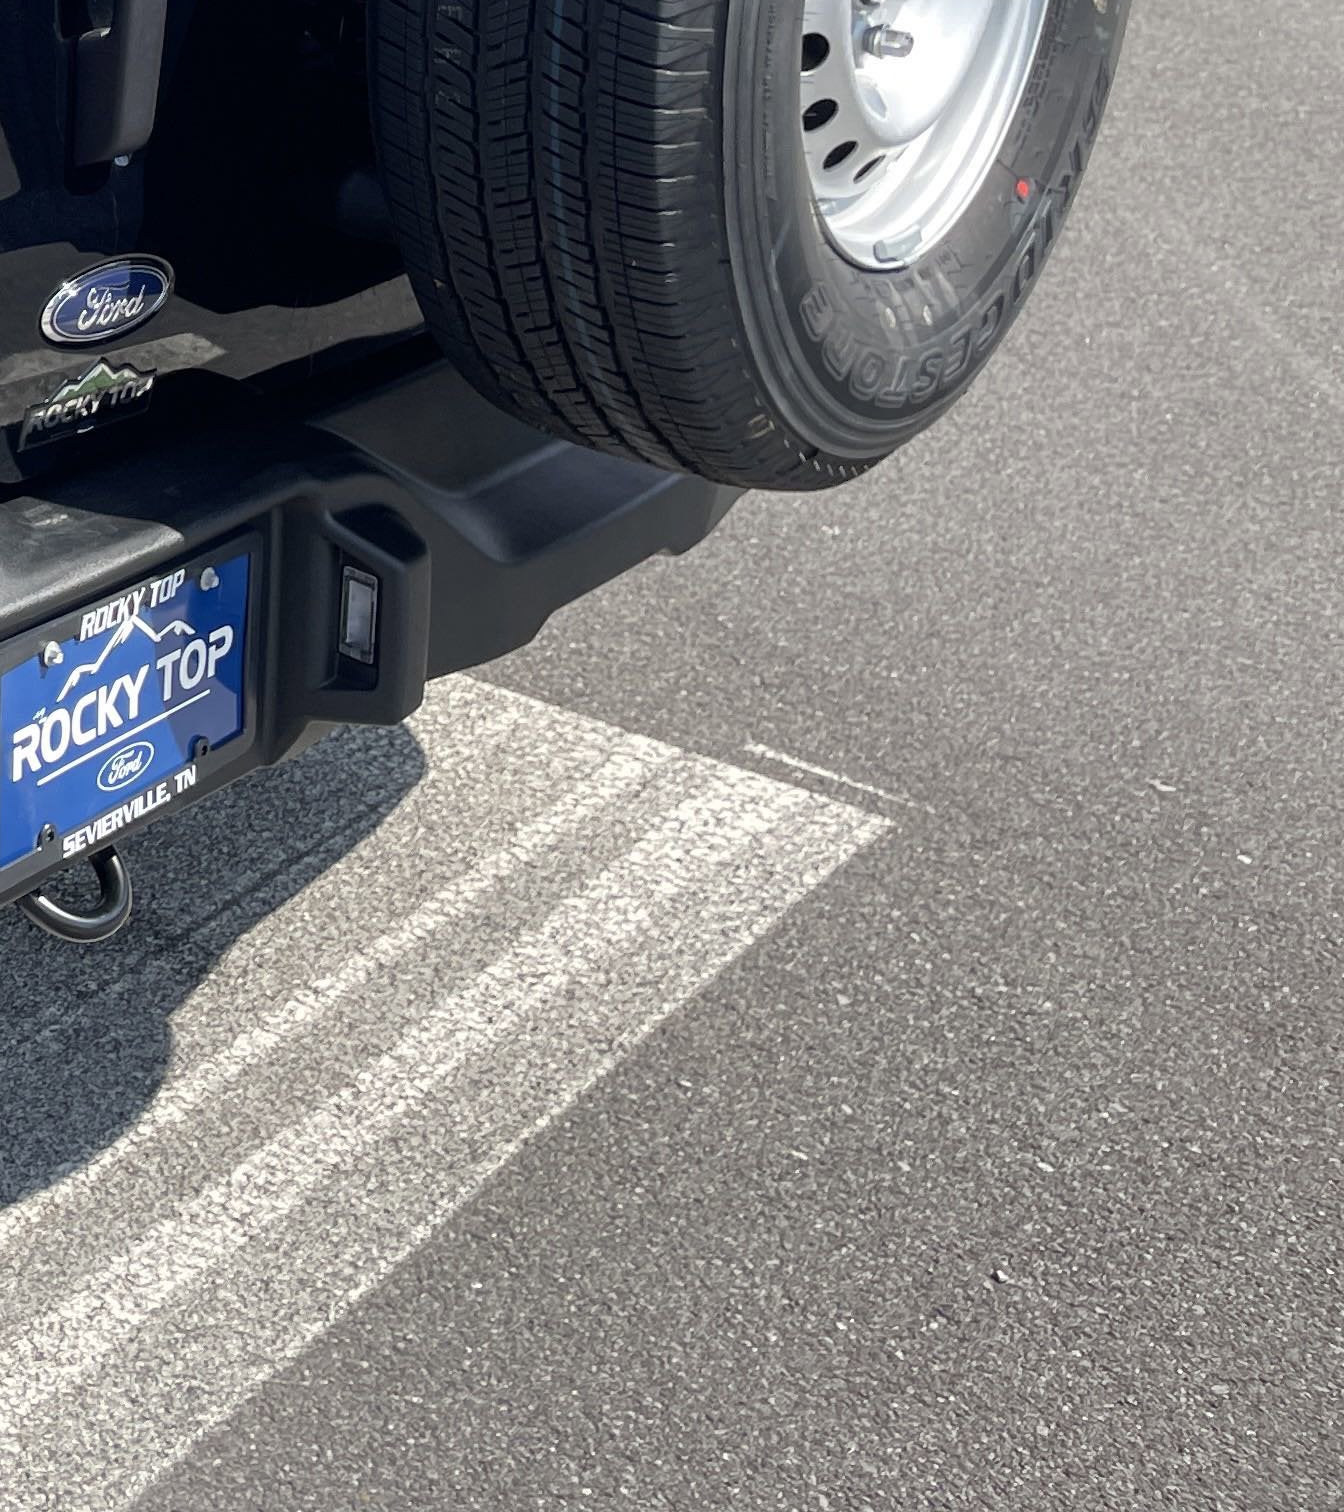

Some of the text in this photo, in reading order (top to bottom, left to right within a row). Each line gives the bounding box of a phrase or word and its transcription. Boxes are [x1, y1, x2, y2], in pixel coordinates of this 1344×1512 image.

[77, 280, 146, 331] Ford
[29, 389, 105, 432] ROCKY
[79, 568, 186, 642] ROCKY TOP
[12, 624, 234, 783] ROCKY TOP
[108, 748, 143, 781] Ford
[63, 764, 197, 859] SEVIERVILLE, TN
